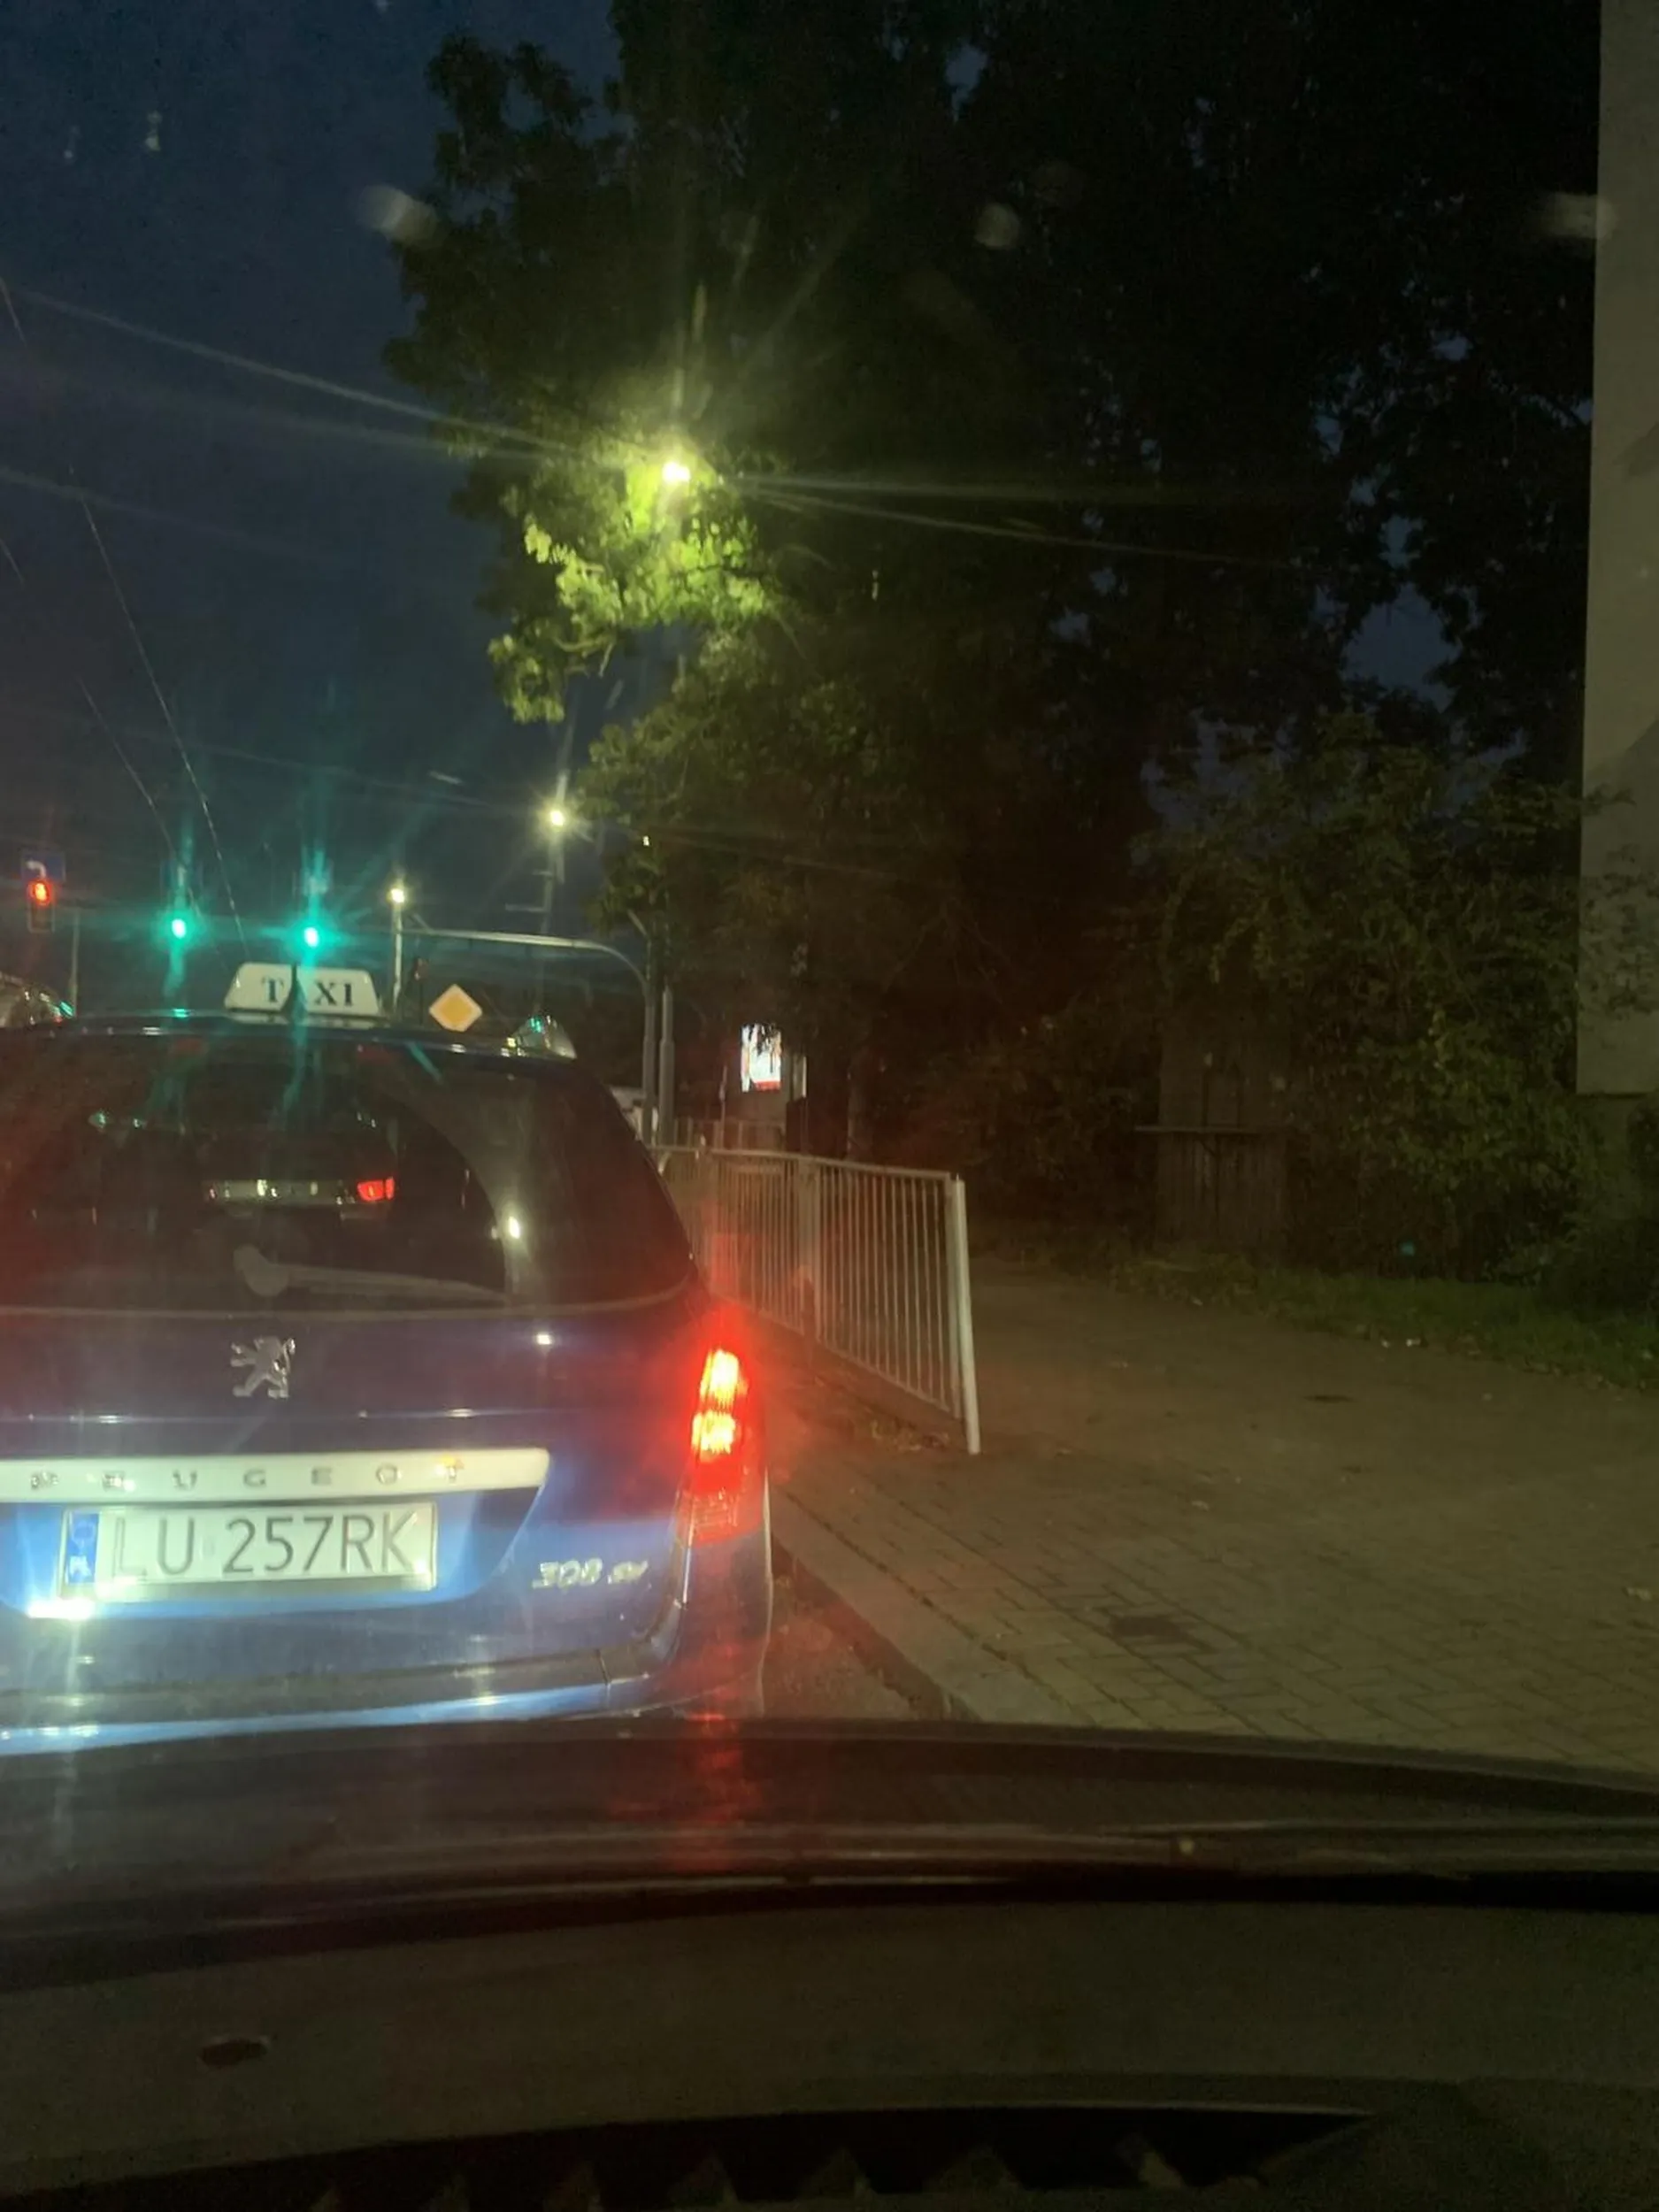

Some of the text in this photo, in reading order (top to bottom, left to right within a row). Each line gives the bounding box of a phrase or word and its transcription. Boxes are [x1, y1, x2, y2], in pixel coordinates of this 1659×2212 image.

[262, 977, 353, 1007] TXI
[111, 1510, 416, 1576] LU 257RK
